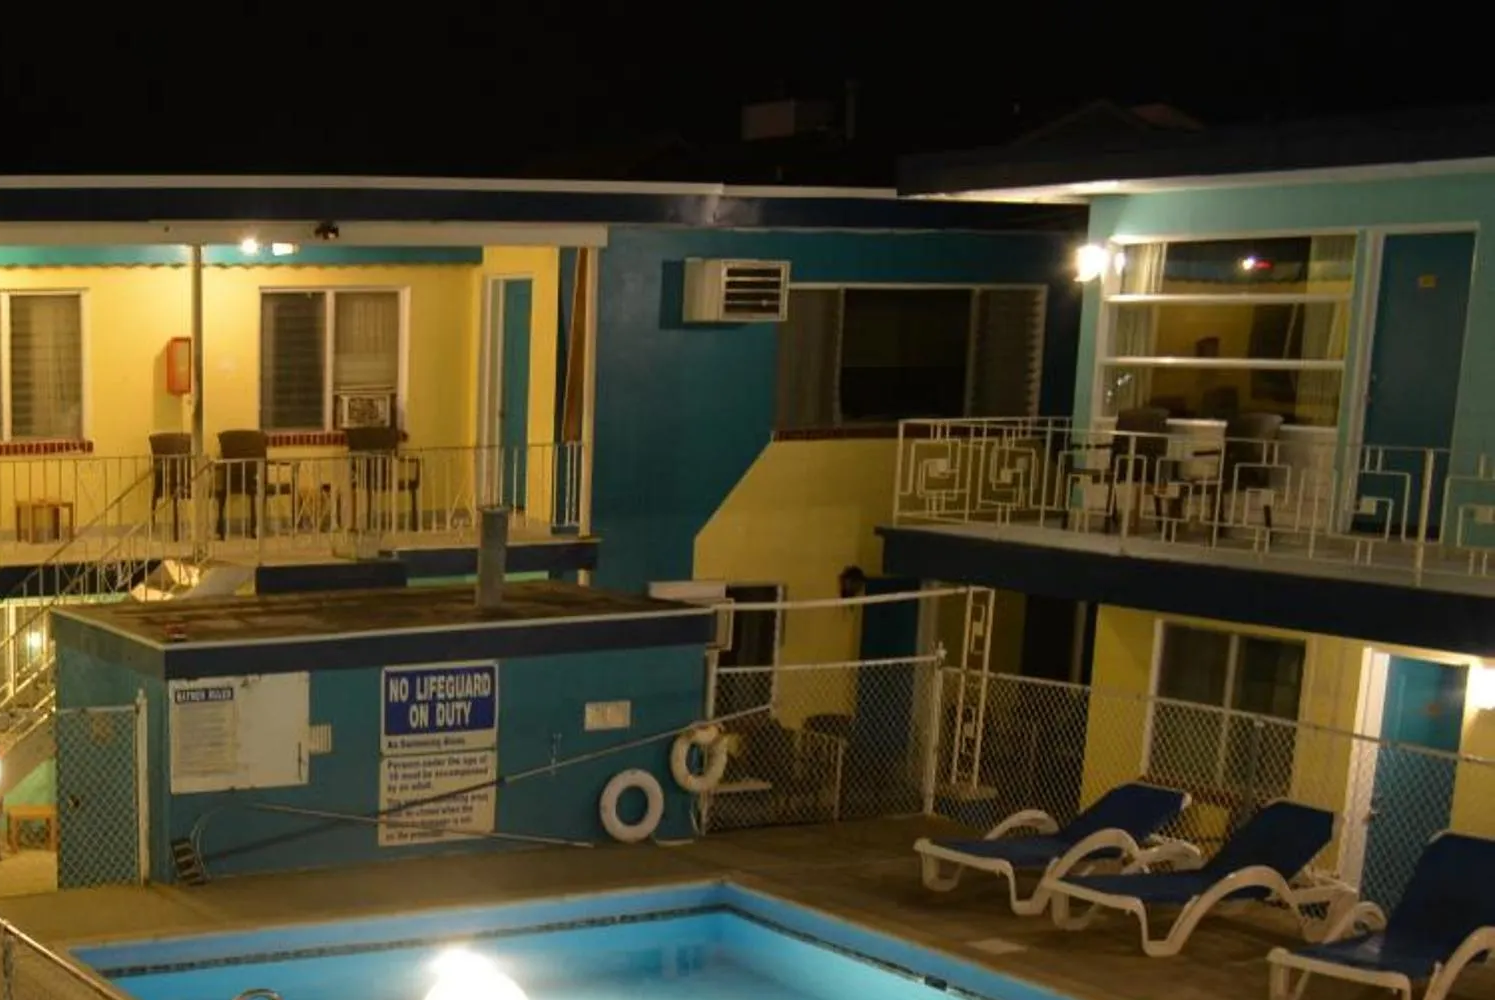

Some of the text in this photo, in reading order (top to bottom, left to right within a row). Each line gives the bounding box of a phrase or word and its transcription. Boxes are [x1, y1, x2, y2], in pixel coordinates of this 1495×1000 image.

[389, 672, 491, 702] NO LIFEGUARD
[409, 701, 473, 729] ON DUTY
